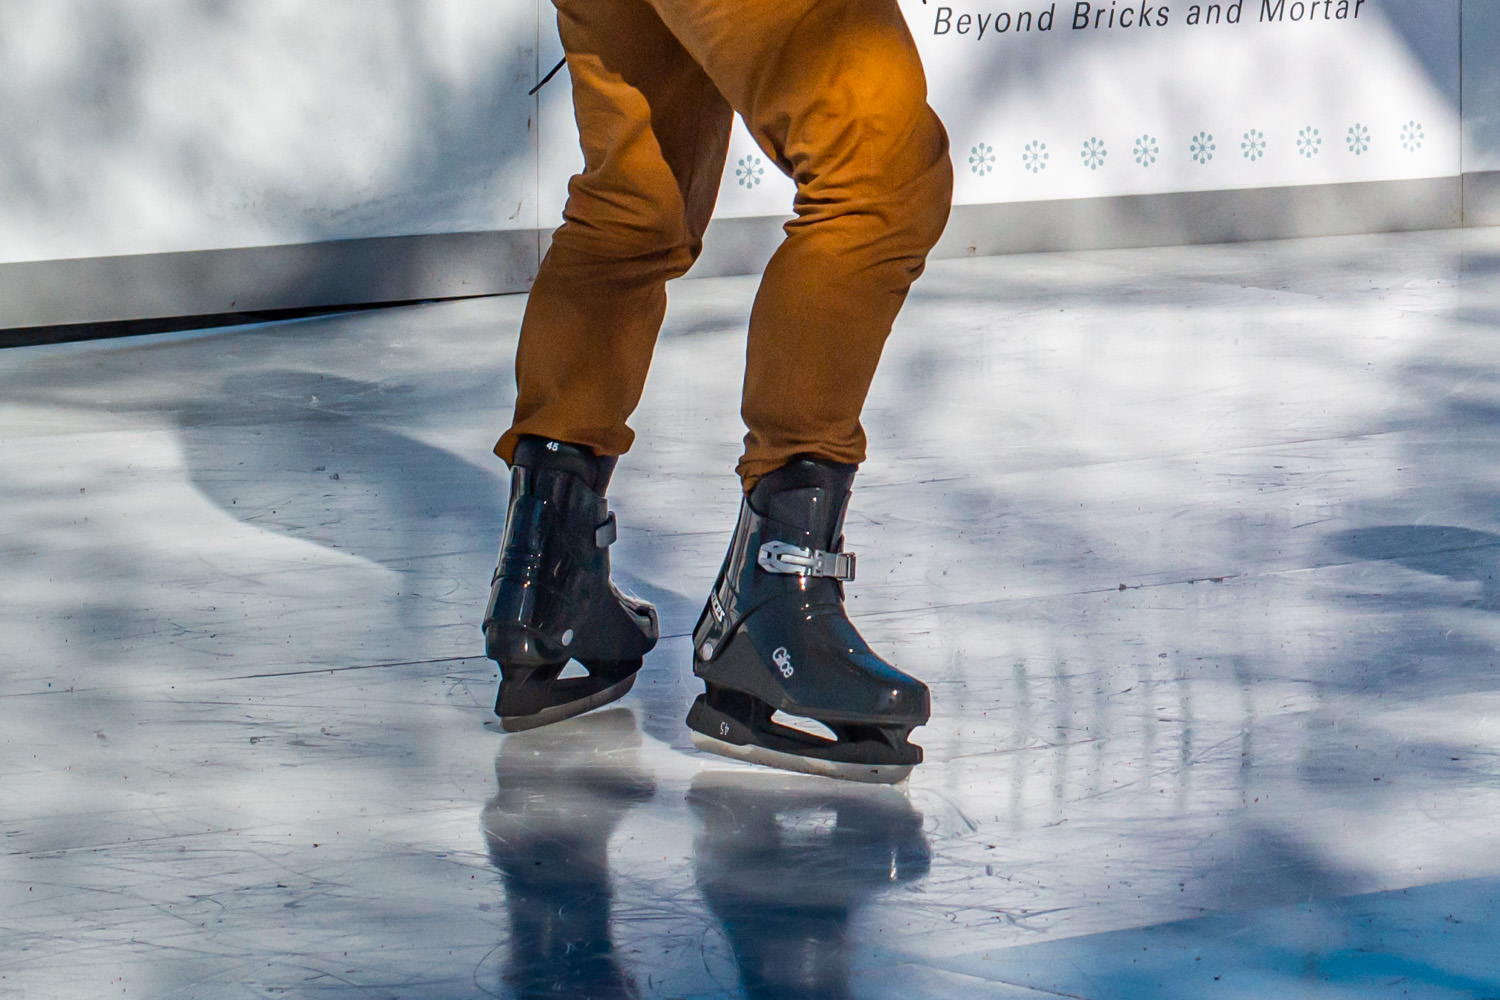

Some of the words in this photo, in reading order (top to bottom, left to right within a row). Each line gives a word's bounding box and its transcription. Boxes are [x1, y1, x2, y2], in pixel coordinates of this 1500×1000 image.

[933, 2, 1055, 41] Beyond
[1072, 0, 1170, 30] Bricks
[546, 441, 560, 451] 45
[772, 646, 794, 678] Glice
